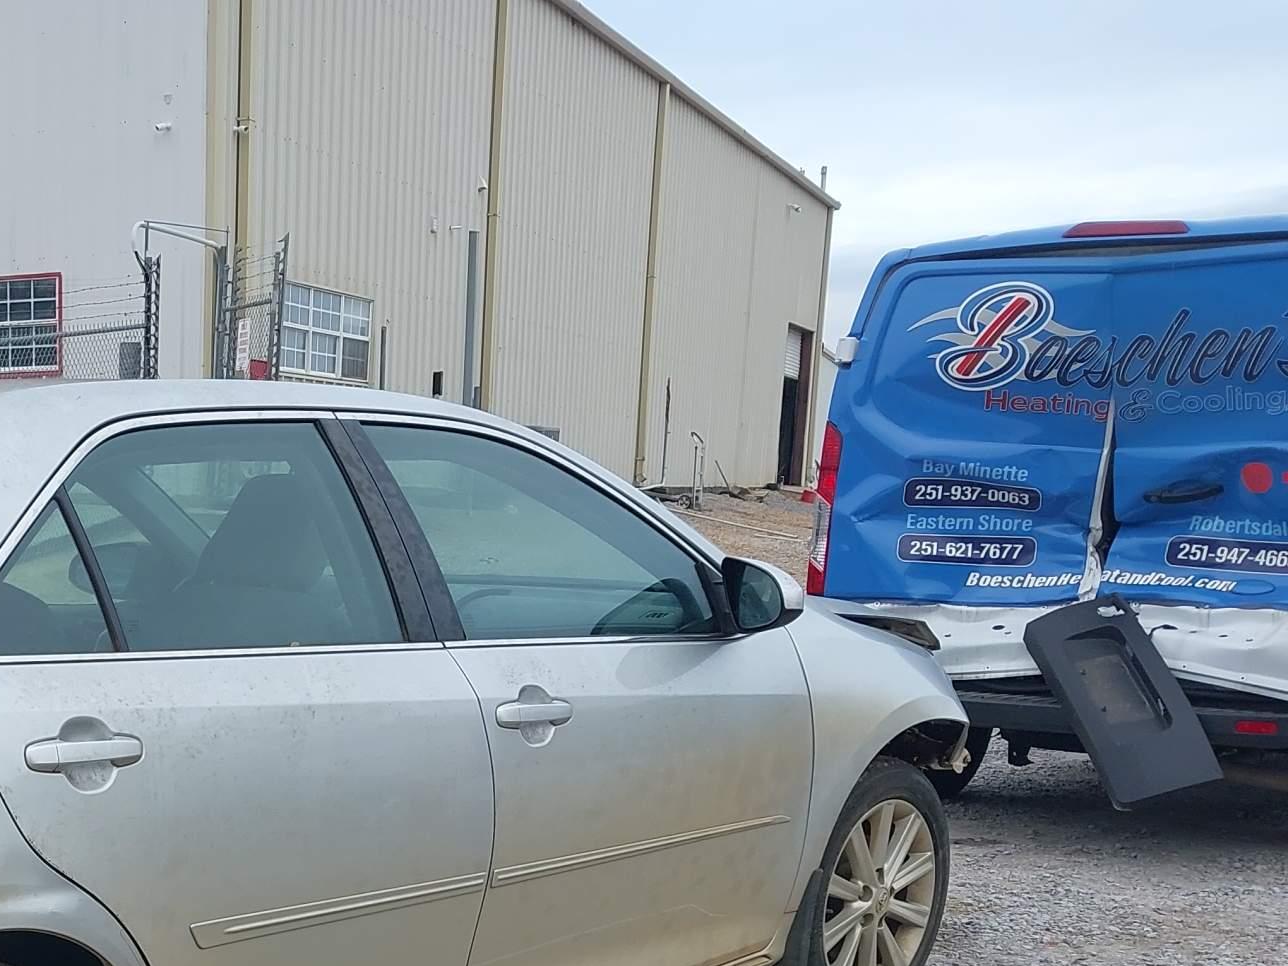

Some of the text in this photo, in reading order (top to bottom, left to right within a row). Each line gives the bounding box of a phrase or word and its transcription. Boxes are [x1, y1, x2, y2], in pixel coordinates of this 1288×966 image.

[935, 278, 1288, 392] Boeschen
[983, 384, 1287, 423] Heating & Cooling
[922, 459, 1029, 482] Bay Minette
[914, 484, 1030, 505] 251-937-0063
[906, 514, 1033, 532] Eastern Shore
[1189, 515, 1288, 537] Robertsdal
[909, 540, 1024, 560] 251-621-7677
[1176, 543, 1288, 568] 251-947-466
